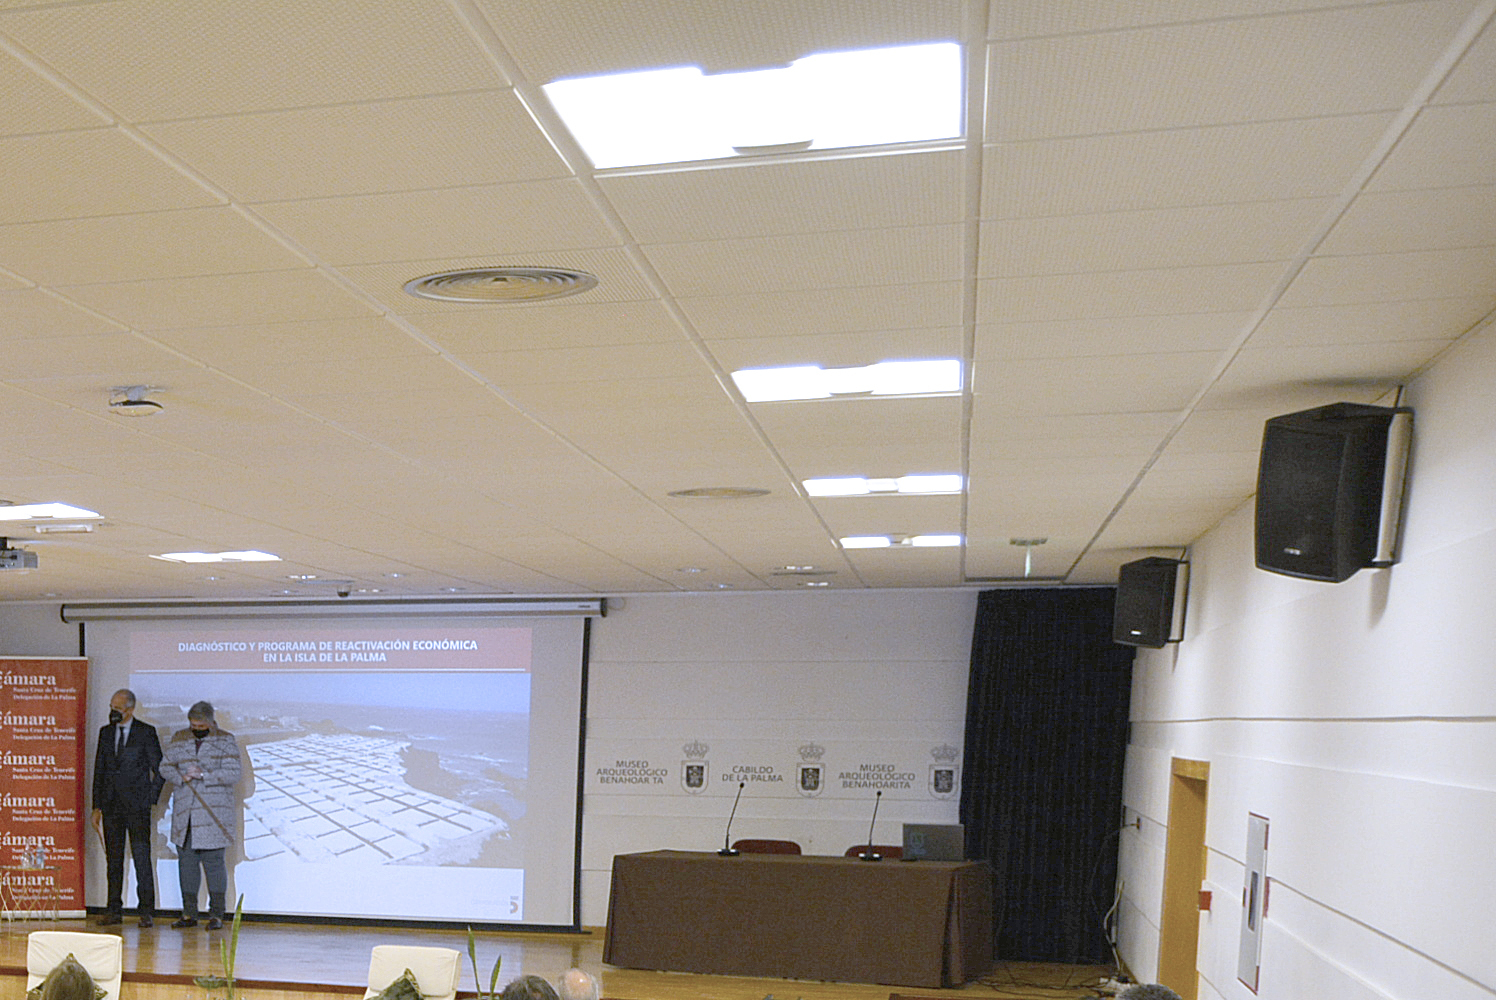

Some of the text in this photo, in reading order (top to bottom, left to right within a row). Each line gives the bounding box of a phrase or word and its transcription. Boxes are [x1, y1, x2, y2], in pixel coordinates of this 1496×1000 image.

[178, 638, 478, 652] DIAGNÓSTICO Y PROGRAMA DE REACTIVACIÓN ECONÓMICA
[263, 652, 387, 662] EN LA ISLA DE LA PALMA
[615, 760, 648, 769] MUSEO
[859, 764, 895, 772] MUSEO
[732, 766, 773, 774] CABILDO
[722, 773, 783, 782] DE LA PALMA
[842, 780, 911, 789] BENAHOARITA
